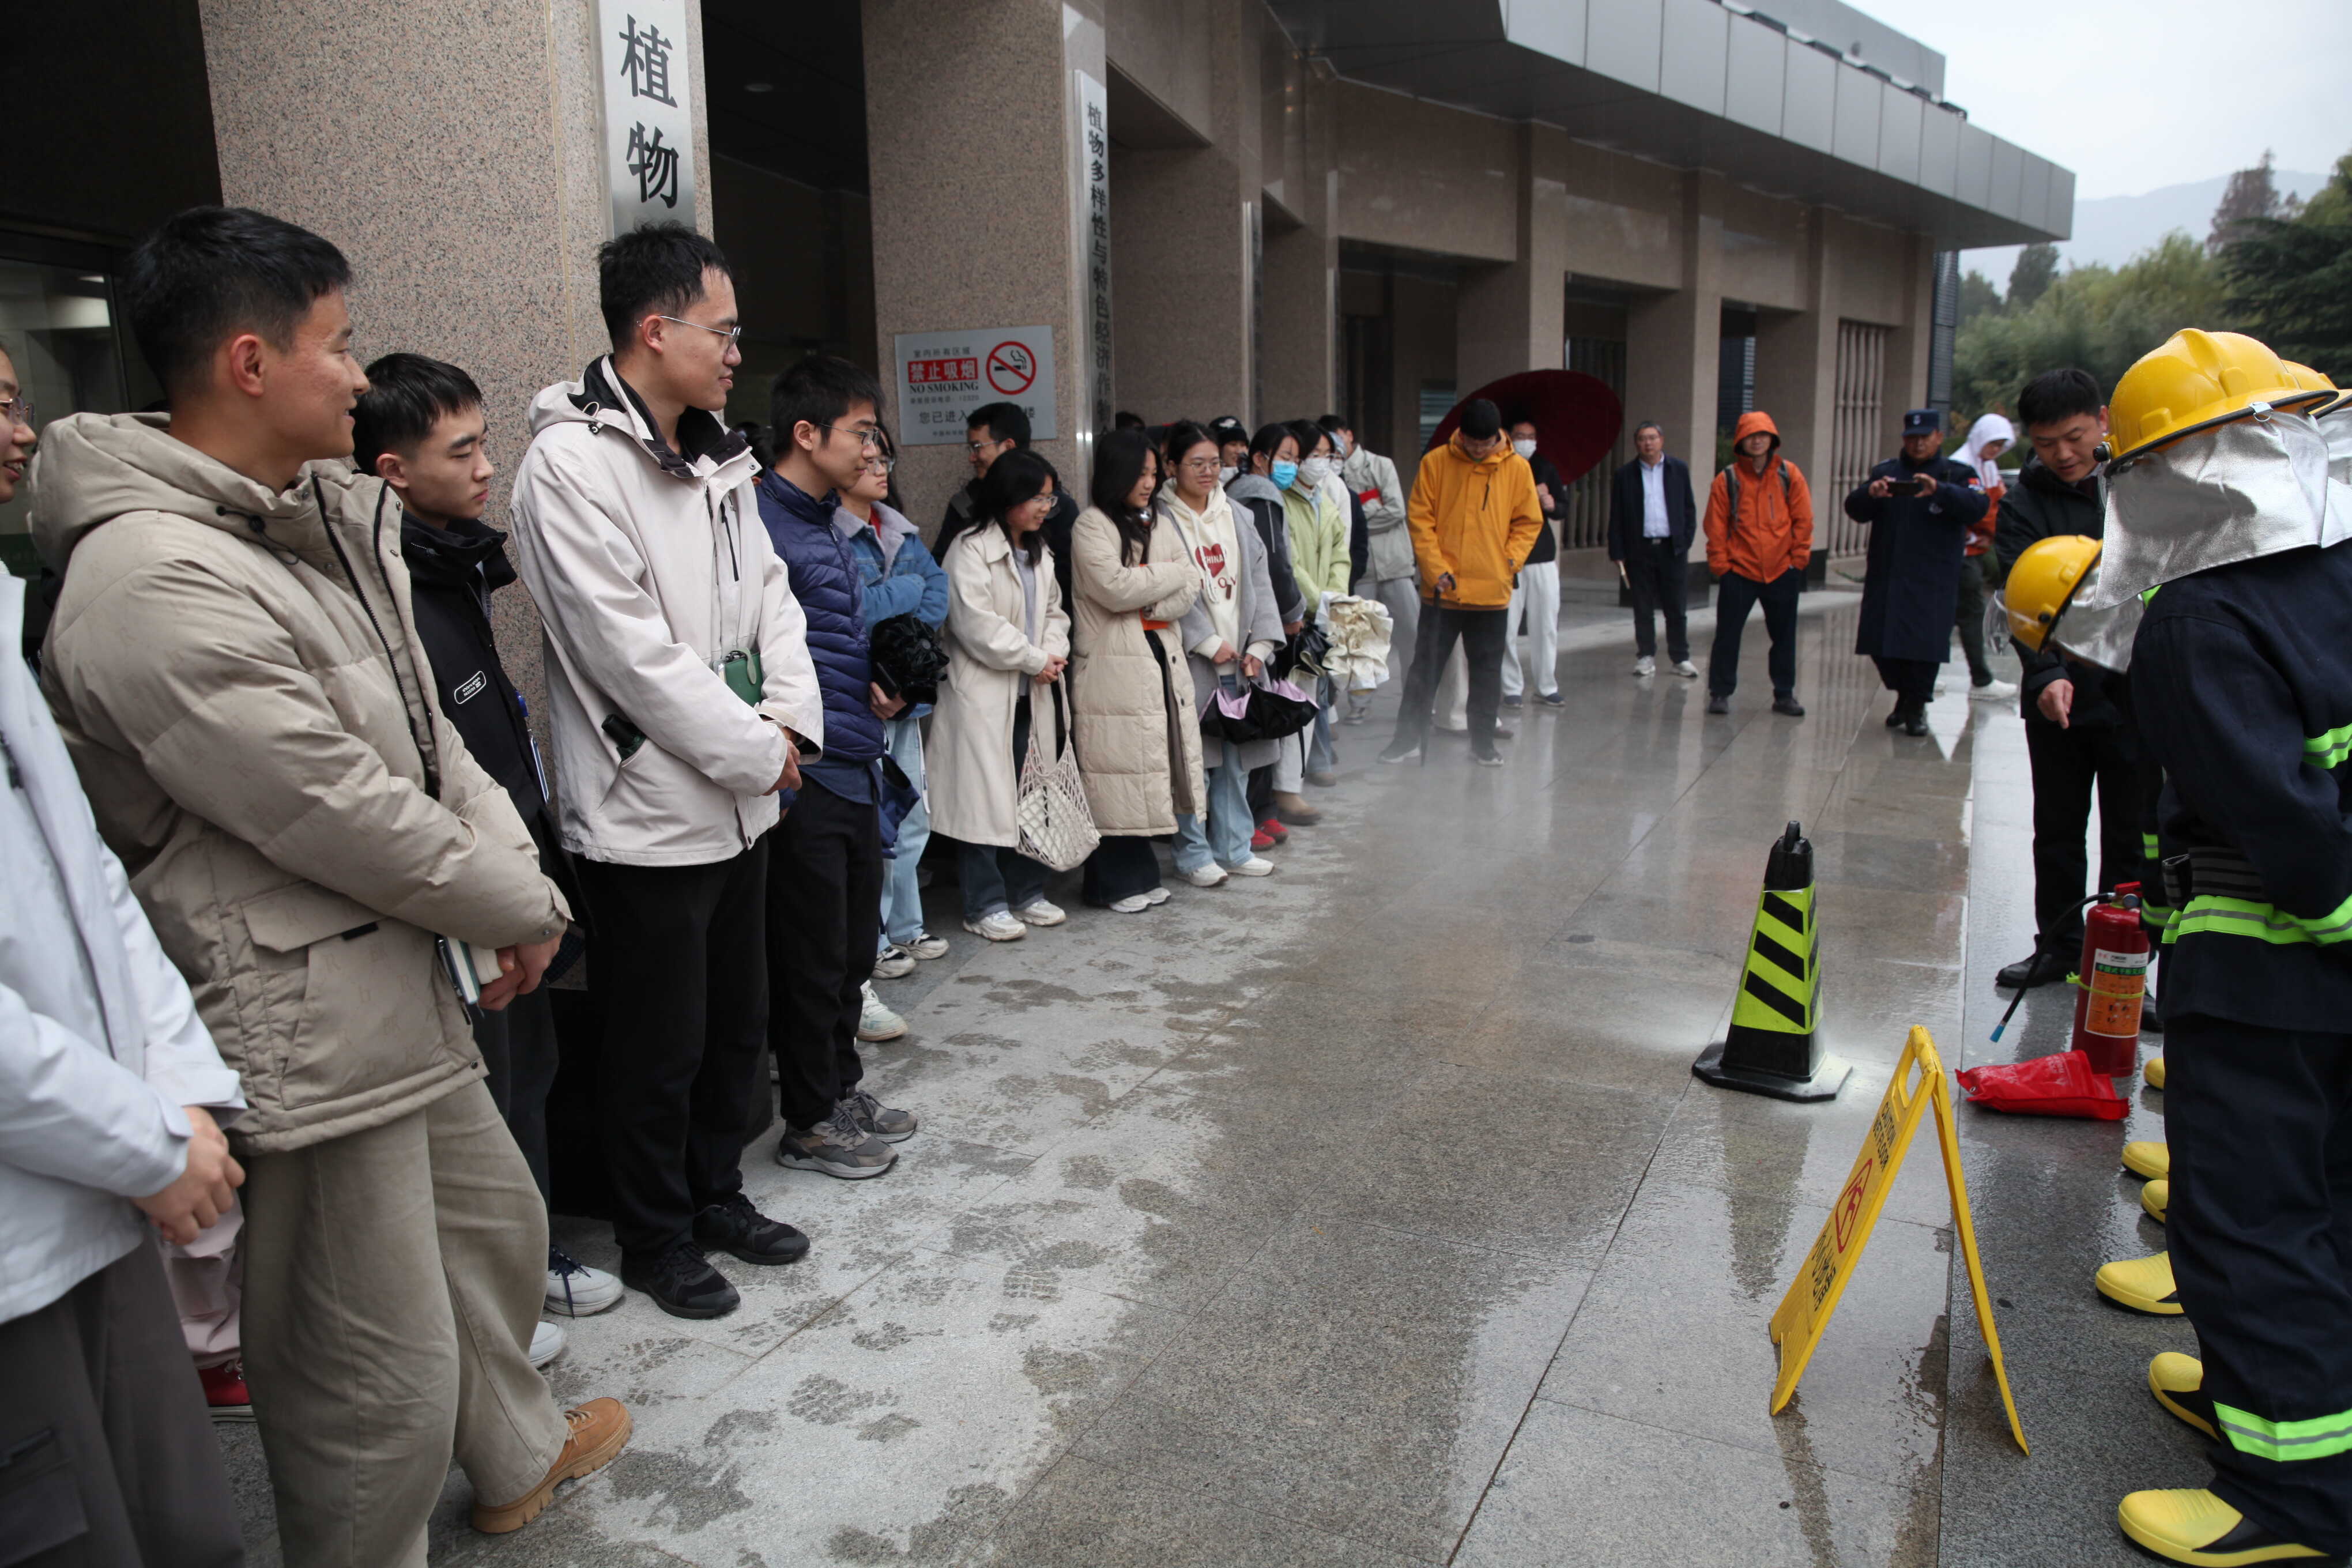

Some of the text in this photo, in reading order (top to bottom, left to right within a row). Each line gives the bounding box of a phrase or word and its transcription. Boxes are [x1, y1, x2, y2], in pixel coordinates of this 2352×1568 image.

[619, 13, 679, 209] 植物
[911, 360, 975, 382] 禁止吸烟
[909, 382, 978, 394] NO SMOKING
[1204, 554, 1224, 564] HINA
[1882, 1102, 1896, 1148] CAUTION
[1876, 1132, 1889, 1172] FLOOR
